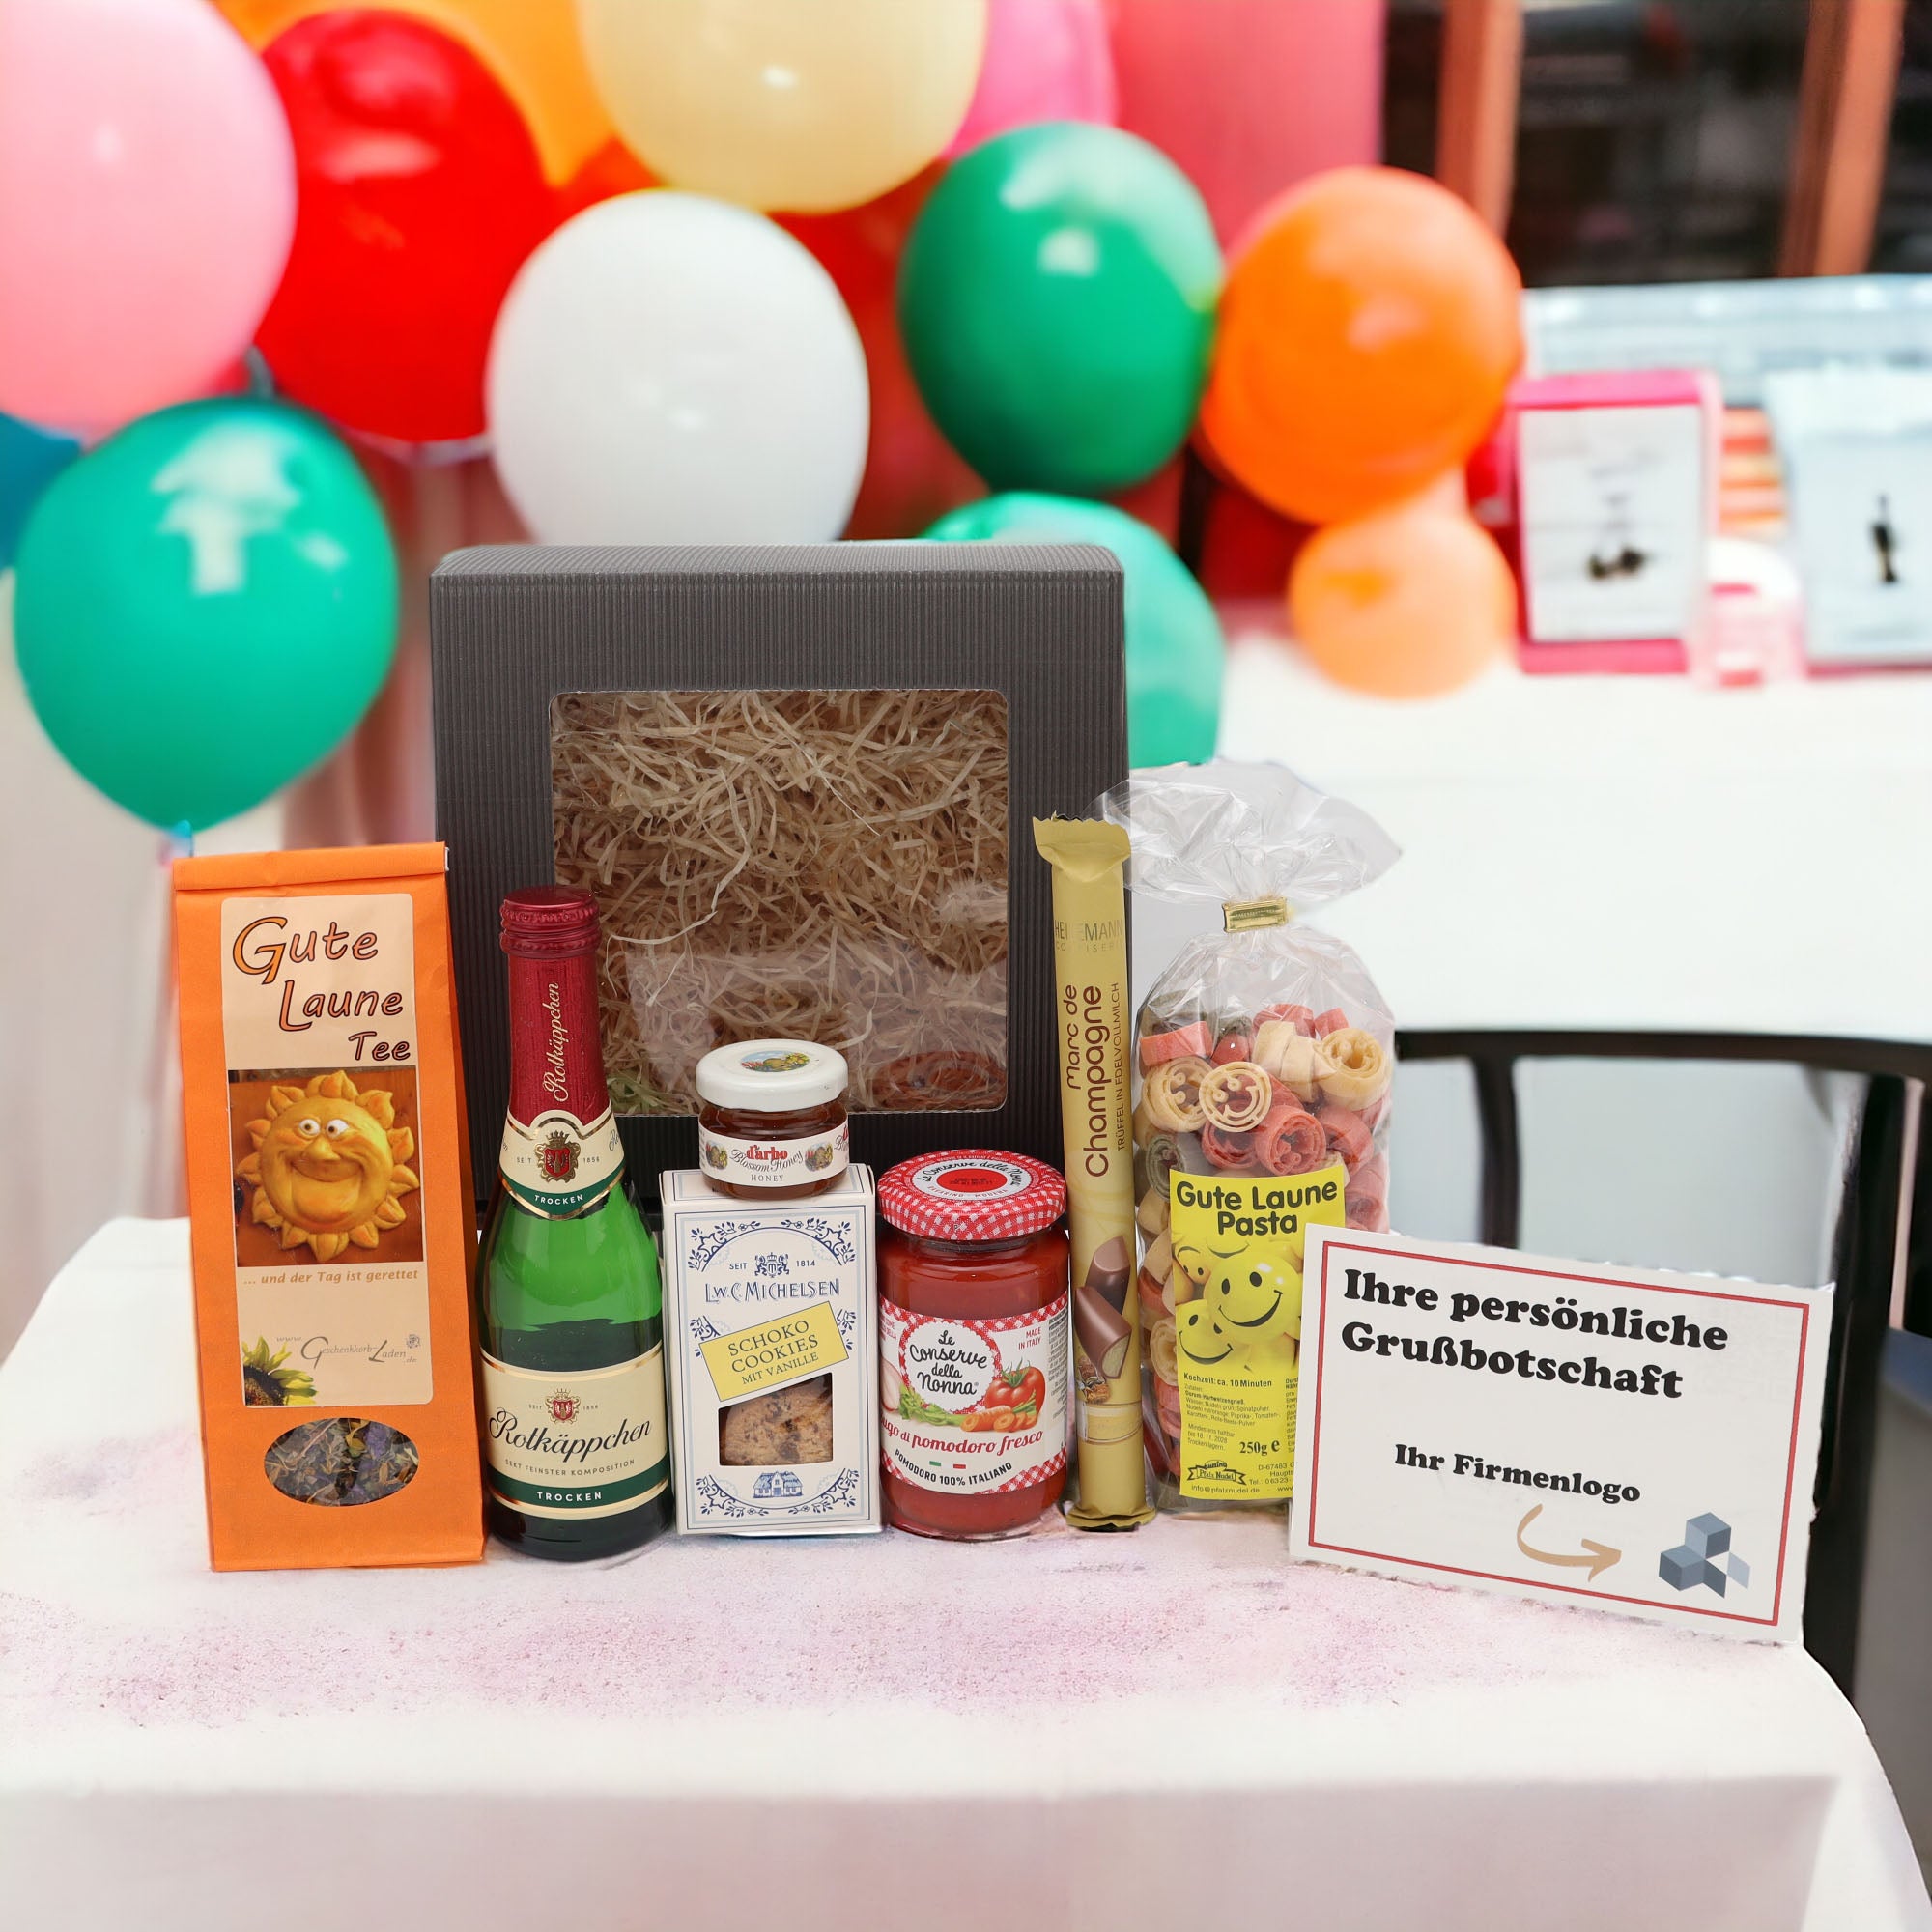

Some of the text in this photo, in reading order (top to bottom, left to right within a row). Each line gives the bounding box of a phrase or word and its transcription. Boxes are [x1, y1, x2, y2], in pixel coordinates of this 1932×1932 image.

[233, 916, 378, 984] Gute
[279, 980, 403, 1032] Laune
[1064, 984, 1077, 1016] de
[348, 1031, 411, 1061] Tee
[543, 982, 569, 1102] Rotkäppchen
[1111, 982, 1125, 1152] TRÜFFEL IN EDELVOLLMILCH
[1083, 985, 1111, 1178] Champagne
[729, 1148, 770, 1171] Blossom
[770, 1149, 804, 1171] Honey
[751, 1174, 784, 1182] HONEY
[535, 1194, 583, 1206] TROCKEN
[1176, 1181, 1337, 1210] Gute Laune
[1217, 1211, 1298, 1236] Pasta
[261, 1273, 286, 1284] und
[290, 1272, 313, 1283] der
[317, 1271, 341, 1284] Tag
[346, 1271, 362, 1281] ist
[366, 1269, 418, 1283] gerettet
[729, 1259, 816, 1270] SEIT 1814
[745, 1278, 840, 1302] MICHELSEN
[1344, 1268, 1729, 1351] Ihre persönliche
[728, 1320, 810, 1357] SCHOKO
[938, 1330, 956, 1346] Le
[1025, 1327, 1041, 1338] MADE
[1026, 1337, 1042, 1349] ITALY
[731, 1334, 819, 1373] COOKIES
[909, 1344, 988, 1369] Conserve
[1340, 1321, 1684, 1399] Grußbotschaft
[742, 1352, 819, 1385] MIT VANILLE
[932, 1363, 963, 1378] della
[1184, 1372, 1216, 1385] Kochzeit:
[917, 1372, 976, 1395] Nonna
[489, 1406, 653, 1463] Rotkäppchen
[881, 1417, 1044, 1456] ugo di pomodoro fresco
[1240, 1441, 1268, 1456] 250g
[505, 1458, 635, 1476] SEKT FEINSTER KOMPOSITION
[895, 1449, 1013, 1486] POMODORO 100% ITALIANO
[1395, 1444, 1641, 1505] Ihr Firmenlogo
[537, 1491, 602, 1502] TROCKEN
